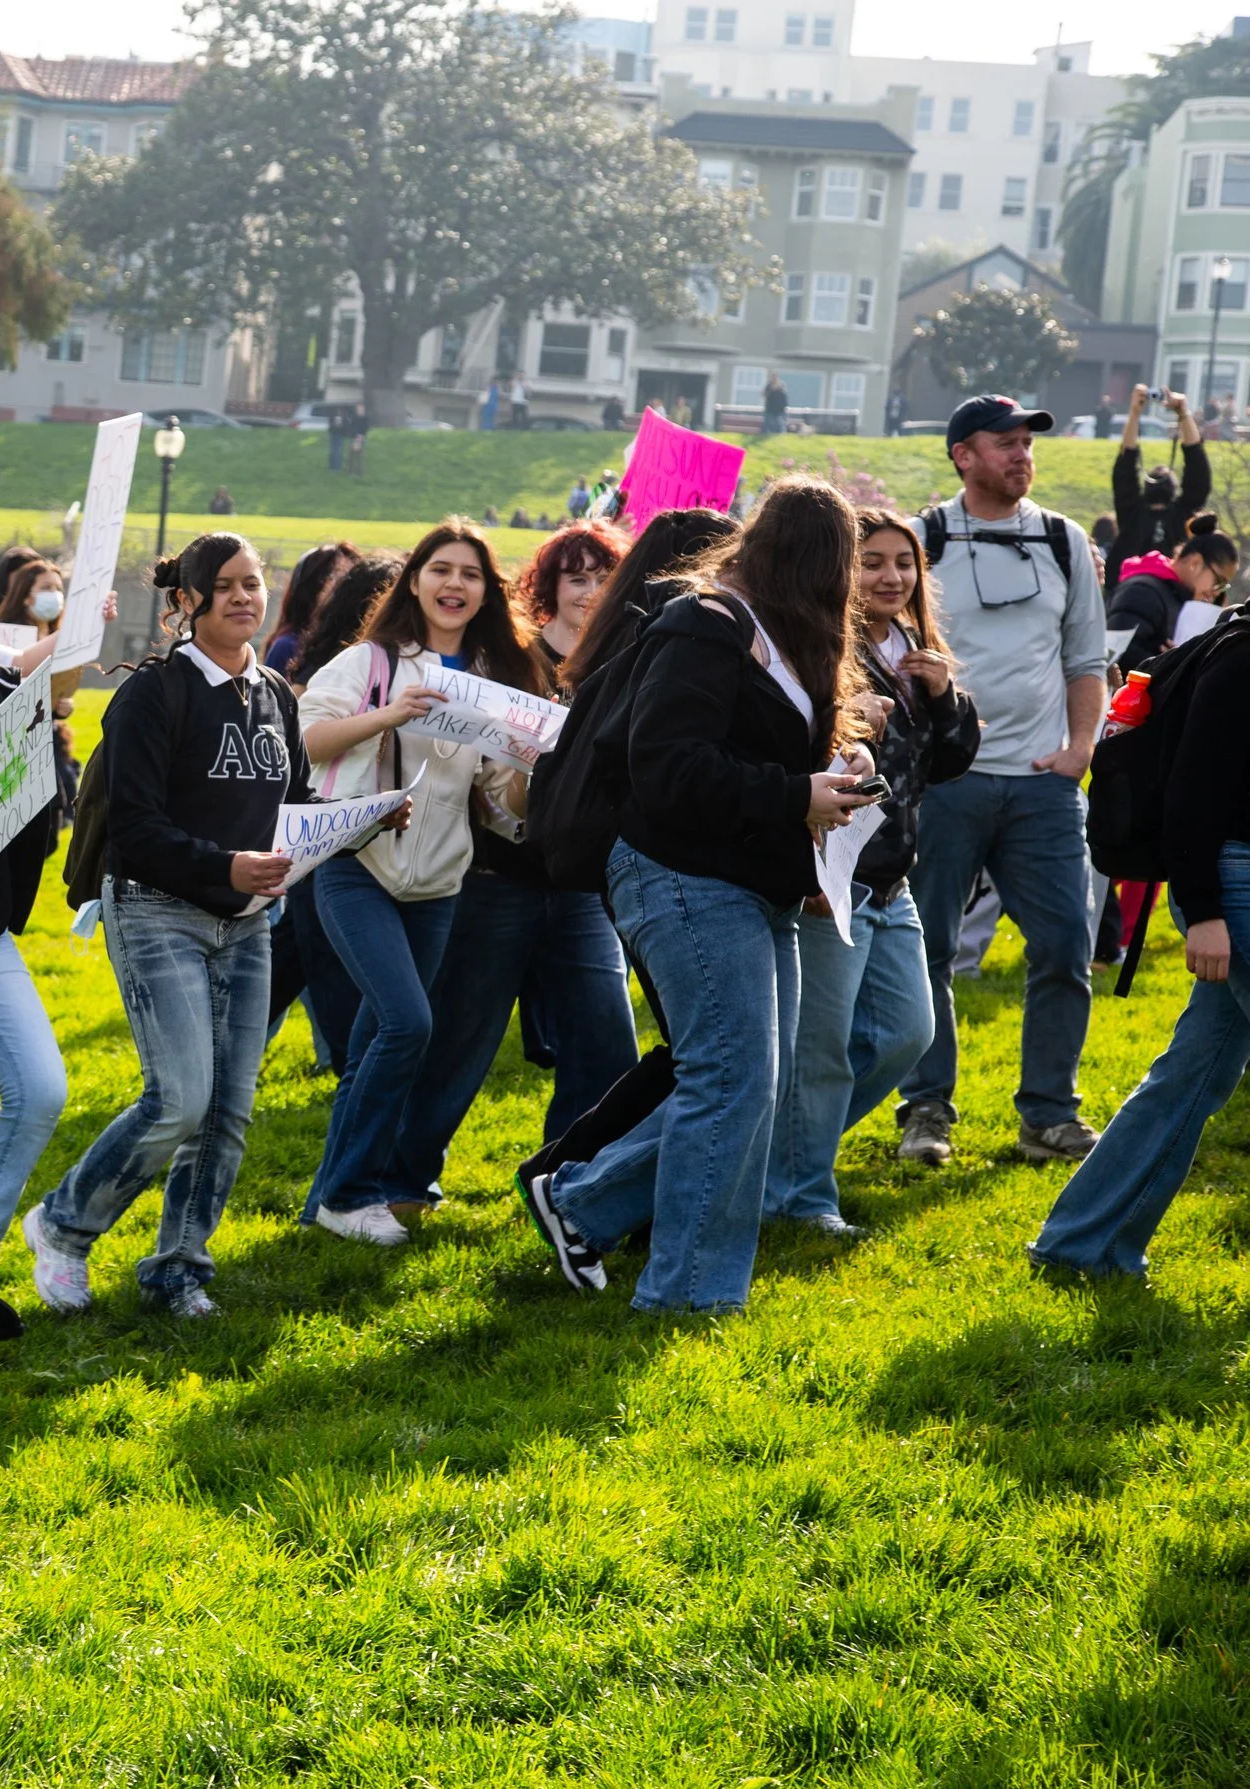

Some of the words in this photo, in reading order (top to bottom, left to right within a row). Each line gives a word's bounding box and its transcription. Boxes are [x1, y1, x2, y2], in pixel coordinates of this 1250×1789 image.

[424, 666, 494, 713] HATE
[506, 691, 560, 717] WILL
[505, 706, 551, 733] NOT
[479, 724, 504, 746] US
